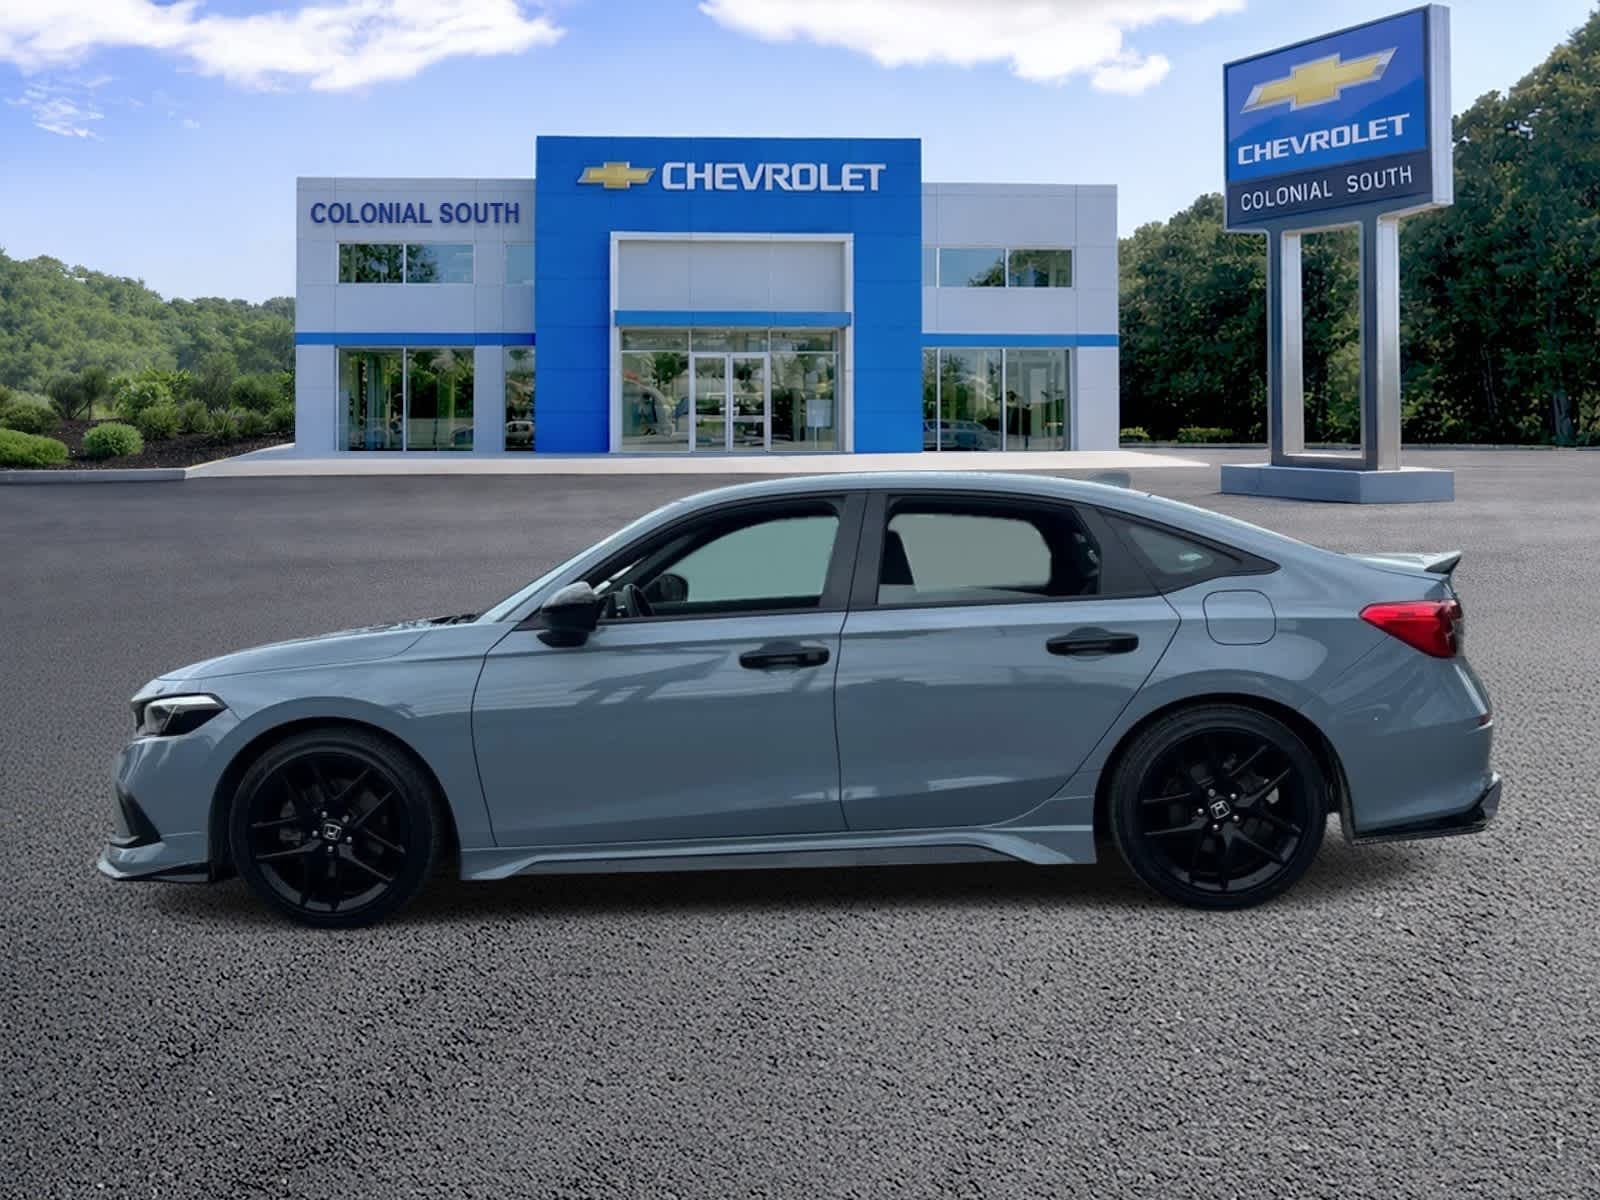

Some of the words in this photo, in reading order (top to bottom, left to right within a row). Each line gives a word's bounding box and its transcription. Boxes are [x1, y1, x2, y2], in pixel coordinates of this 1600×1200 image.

[1237, 113, 1410, 165] CHEVROLET
[662, 162, 886, 192] CHEVROLET
[1241, 180, 1333, 211] COLONIAL
[1346, 165, 1412, 193] SOUTH
[310, 202, 433, 224] COLONIAL
[439, 202, 520, 224] SOUTH
